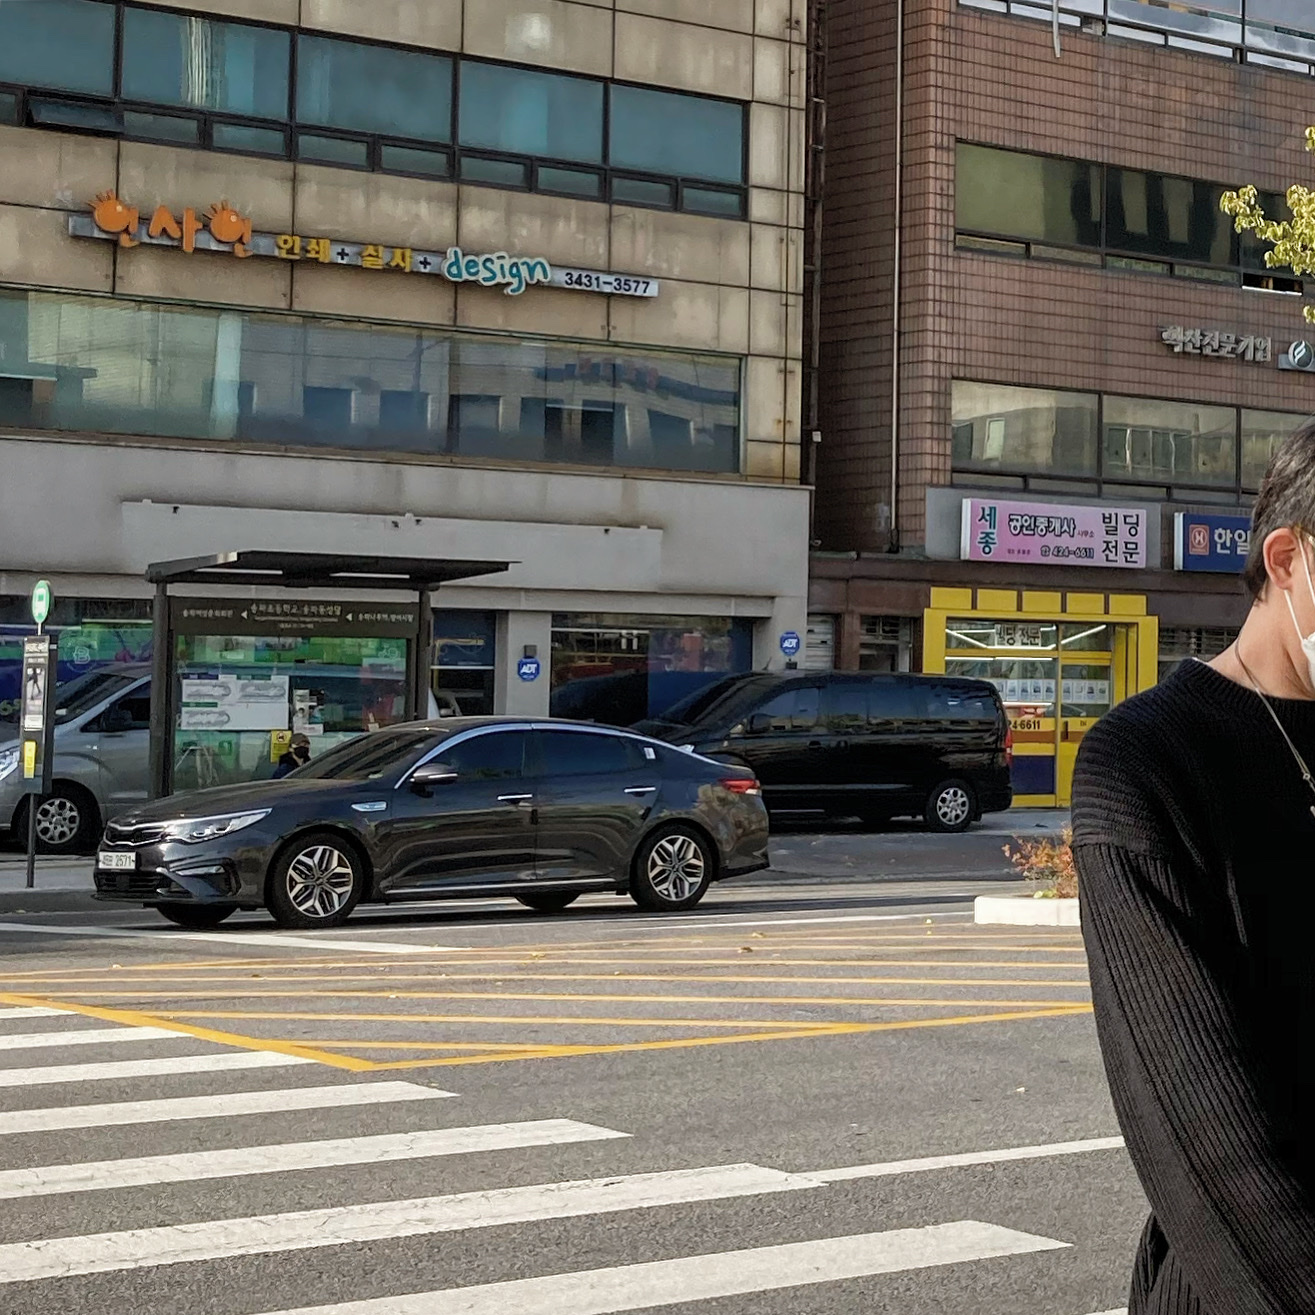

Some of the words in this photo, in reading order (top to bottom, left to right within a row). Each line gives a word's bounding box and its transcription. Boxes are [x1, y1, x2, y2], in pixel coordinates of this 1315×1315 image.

[276, 234, 331, 263] 인쇄
[446, 249, 550, 294] design
[564, 272, 650, 294] 3431-3577
[977, 505, 998, 556] 세종
[1008, 513, 1076, 538] 공인중개사
[1101, 512, 1140, 537] 빌딩
[1052, 545, 1095, 559] 424-6611
[1101, 540, 1140, 564] 전문
[782, 638, 798, 648] ADT
[519, 663, 538, 674] ADT
